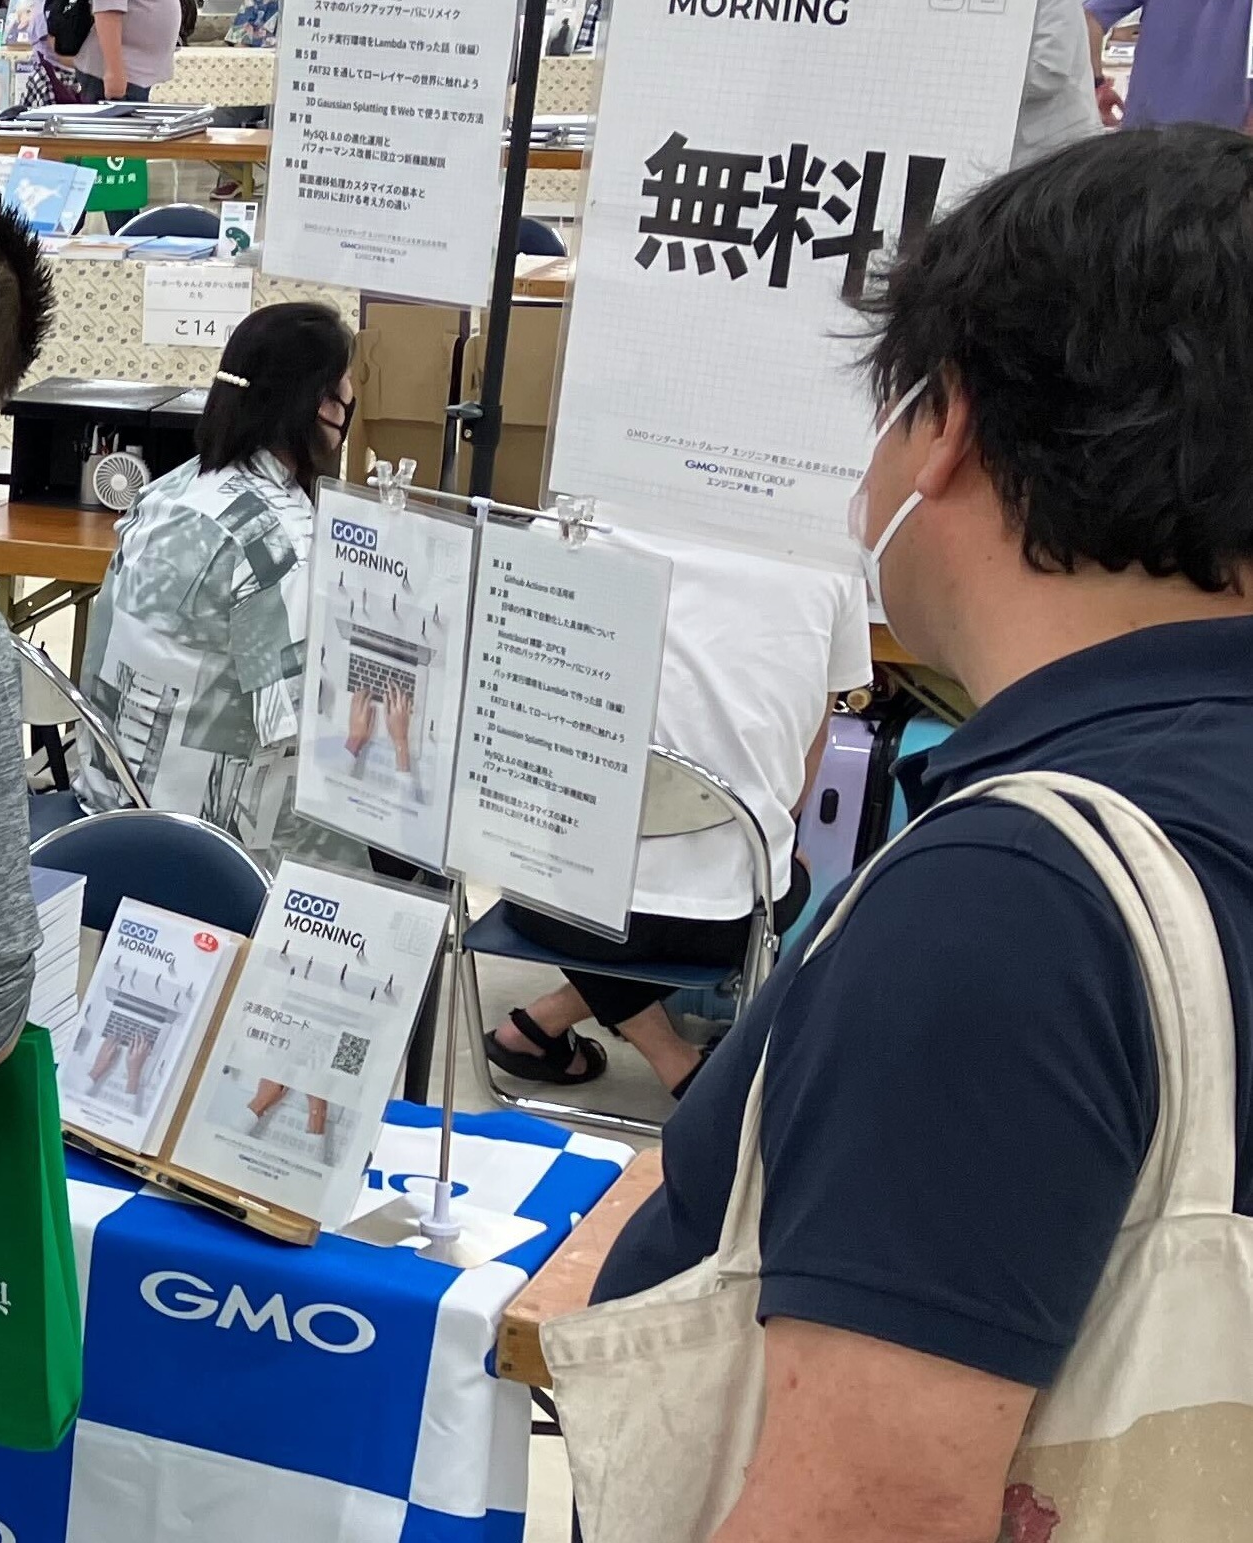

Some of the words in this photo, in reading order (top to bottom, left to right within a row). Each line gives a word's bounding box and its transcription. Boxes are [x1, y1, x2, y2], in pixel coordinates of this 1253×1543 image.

[668, 0, 849, 26] MORNING
[306, 97, 316, 108] 3D
[317, 98, 352, 111] Gaussian
[353, 102, 388, 117] Splatting
[303, 128, 329, 142] MySQL
[685, 459, 719, 475] GMO
[332, 521, 377, 548] GOOD
[335, 543, 406, 578] MORNING
[287, 893, 337, 918] GOOD
[120, 921, 156, 940] GOOD
[284, 912, 362, 948] MORNING
[118, 936, 175, 963] MORNING
[139, 1271, 376, 1354] GMO
